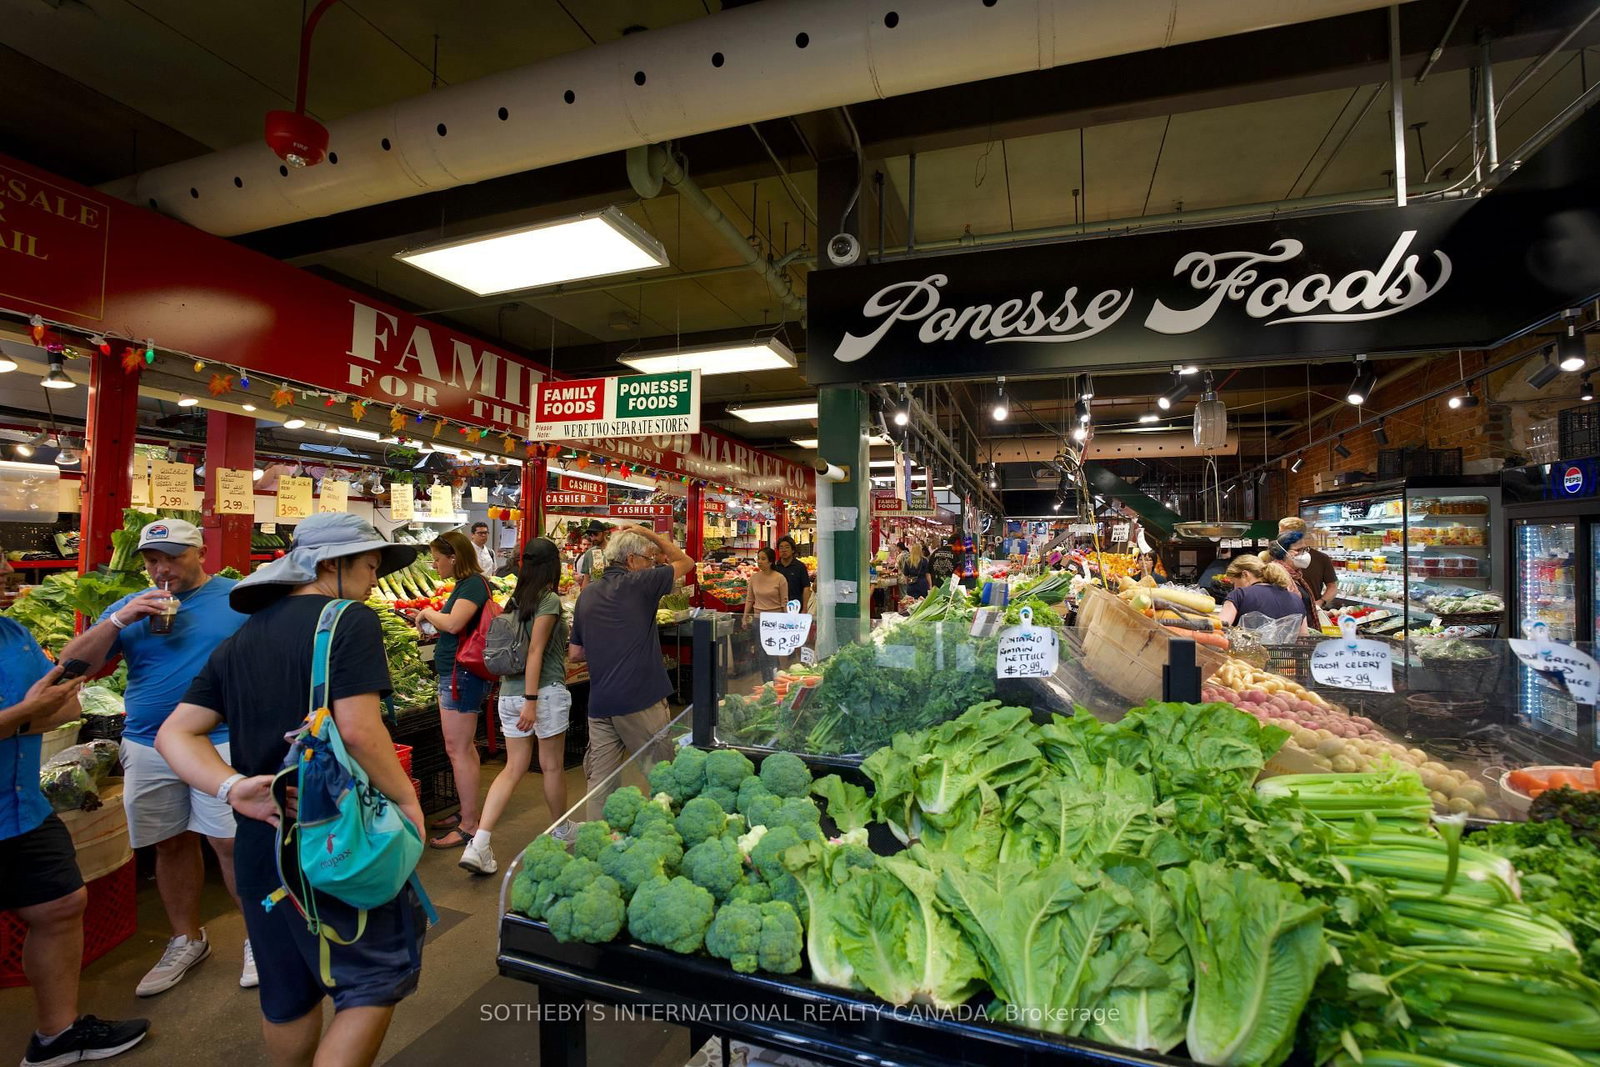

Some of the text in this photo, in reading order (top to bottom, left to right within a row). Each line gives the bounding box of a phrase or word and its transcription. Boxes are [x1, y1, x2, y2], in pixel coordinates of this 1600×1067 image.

[1144, 229, 1452, 334] Foods
[833, 273, 1134, 362] Ponesse
[346, 363, 440, 407] FOR
[620, 379, 688, 397] PONESSE
[543, 386, 597, 402] FAMILY
[543, 400, 596, 416] FOODS
[628, 395, 678, 411] FOODS
[564, 417, 689, 438] WE'RE TWO SEPARATE STORES
[700, 431, 784, 480] MARKET
[569, 479, 604, 494] CASHIER 3
[546, 494, 599, 504] CASHIER 3
[617, 506, 665, 514] CASHIER 2
